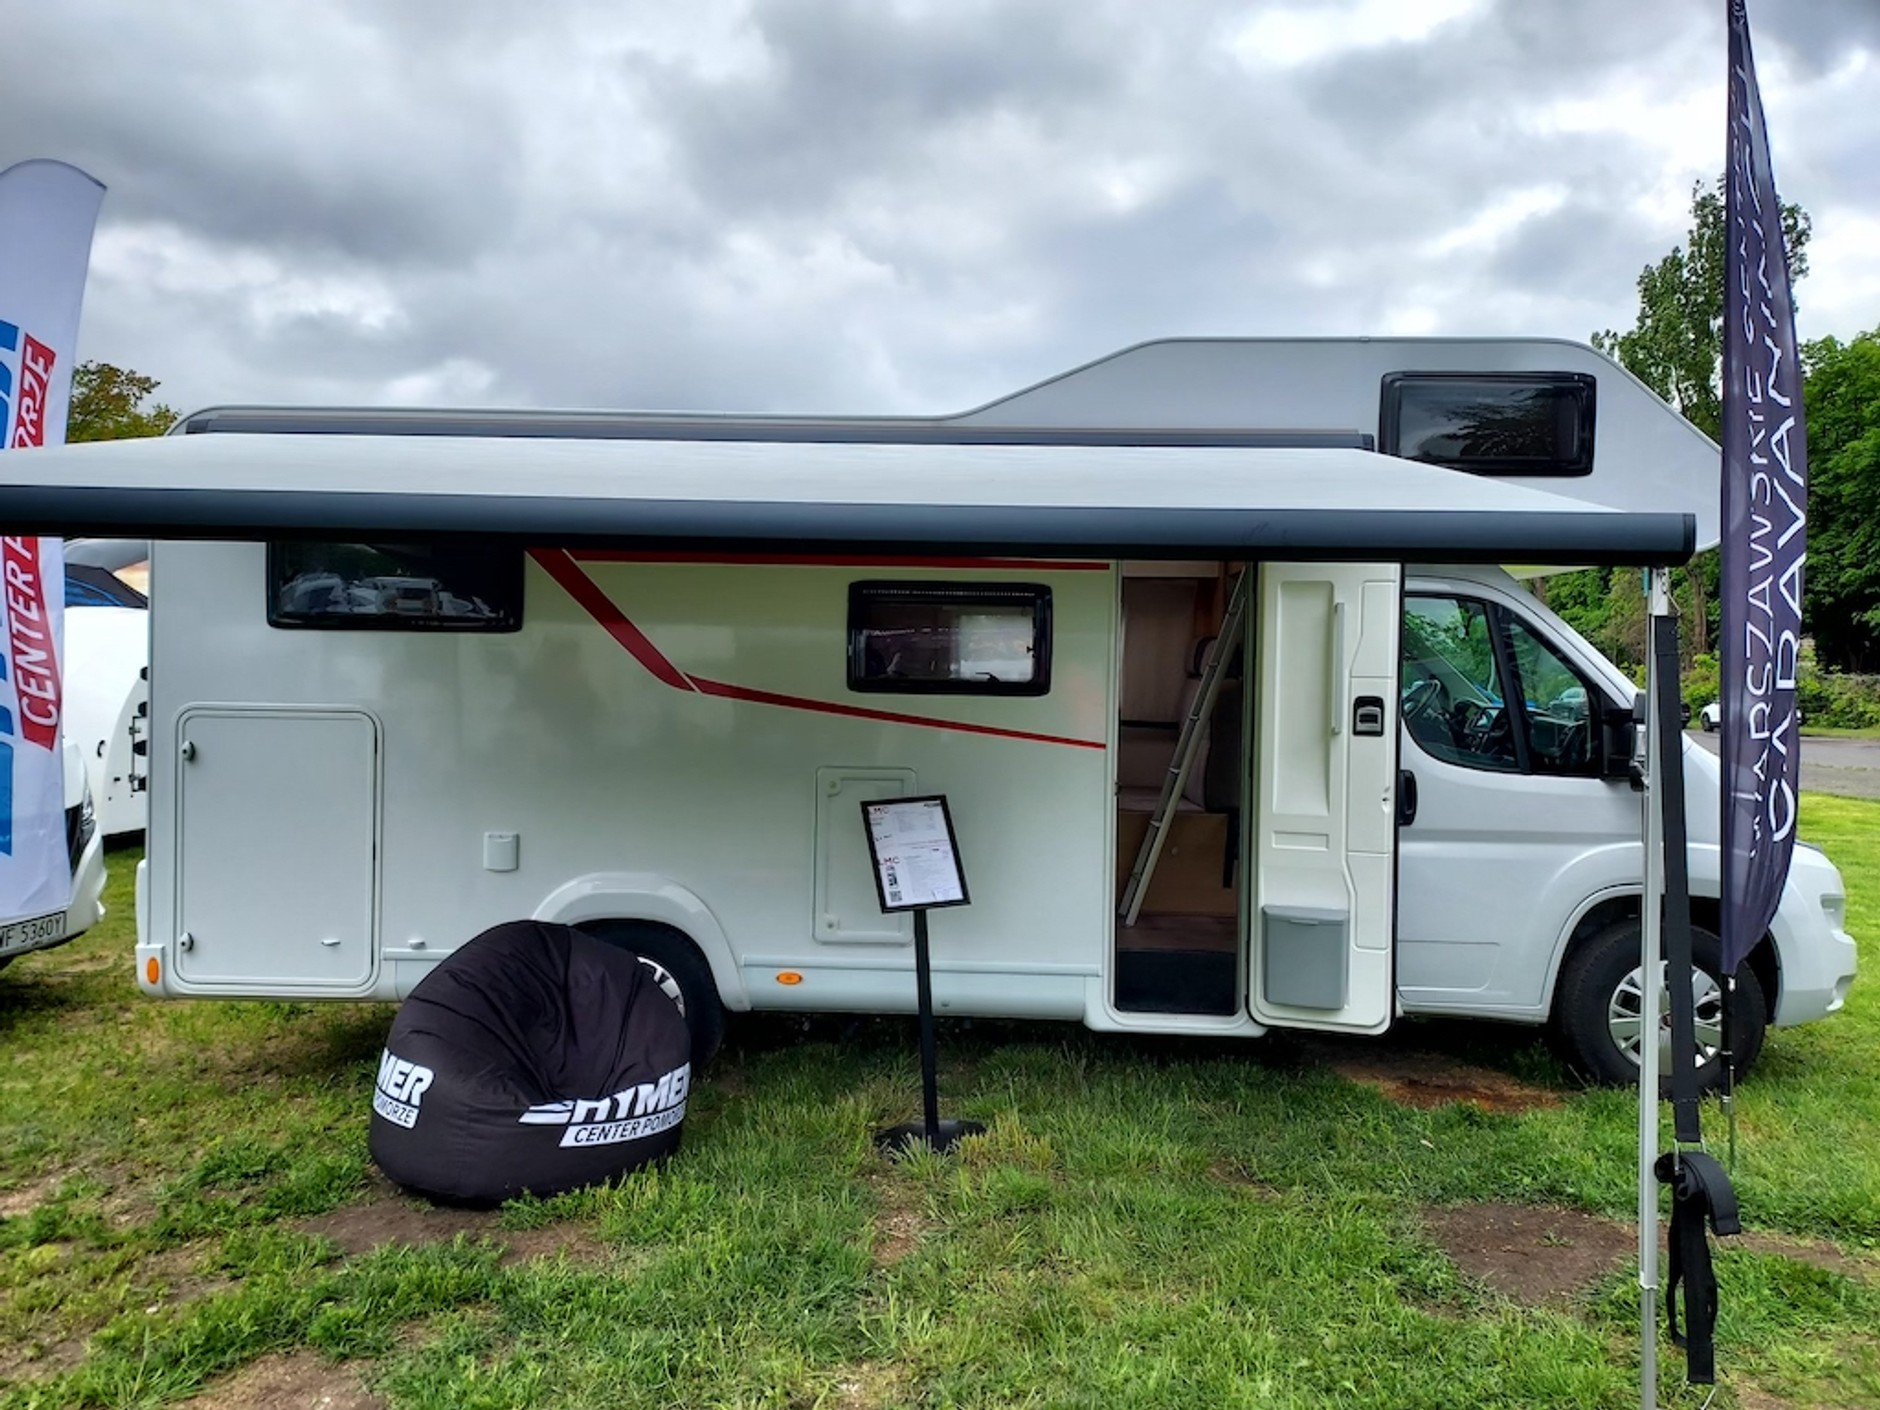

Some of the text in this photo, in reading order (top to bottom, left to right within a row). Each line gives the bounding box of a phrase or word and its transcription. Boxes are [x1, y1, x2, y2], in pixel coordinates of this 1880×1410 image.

[6, 564, 59, 727] CENTER
[21, 916, 62, 943] 5360Y
[574, 1120, 642, 1144] CENTER
